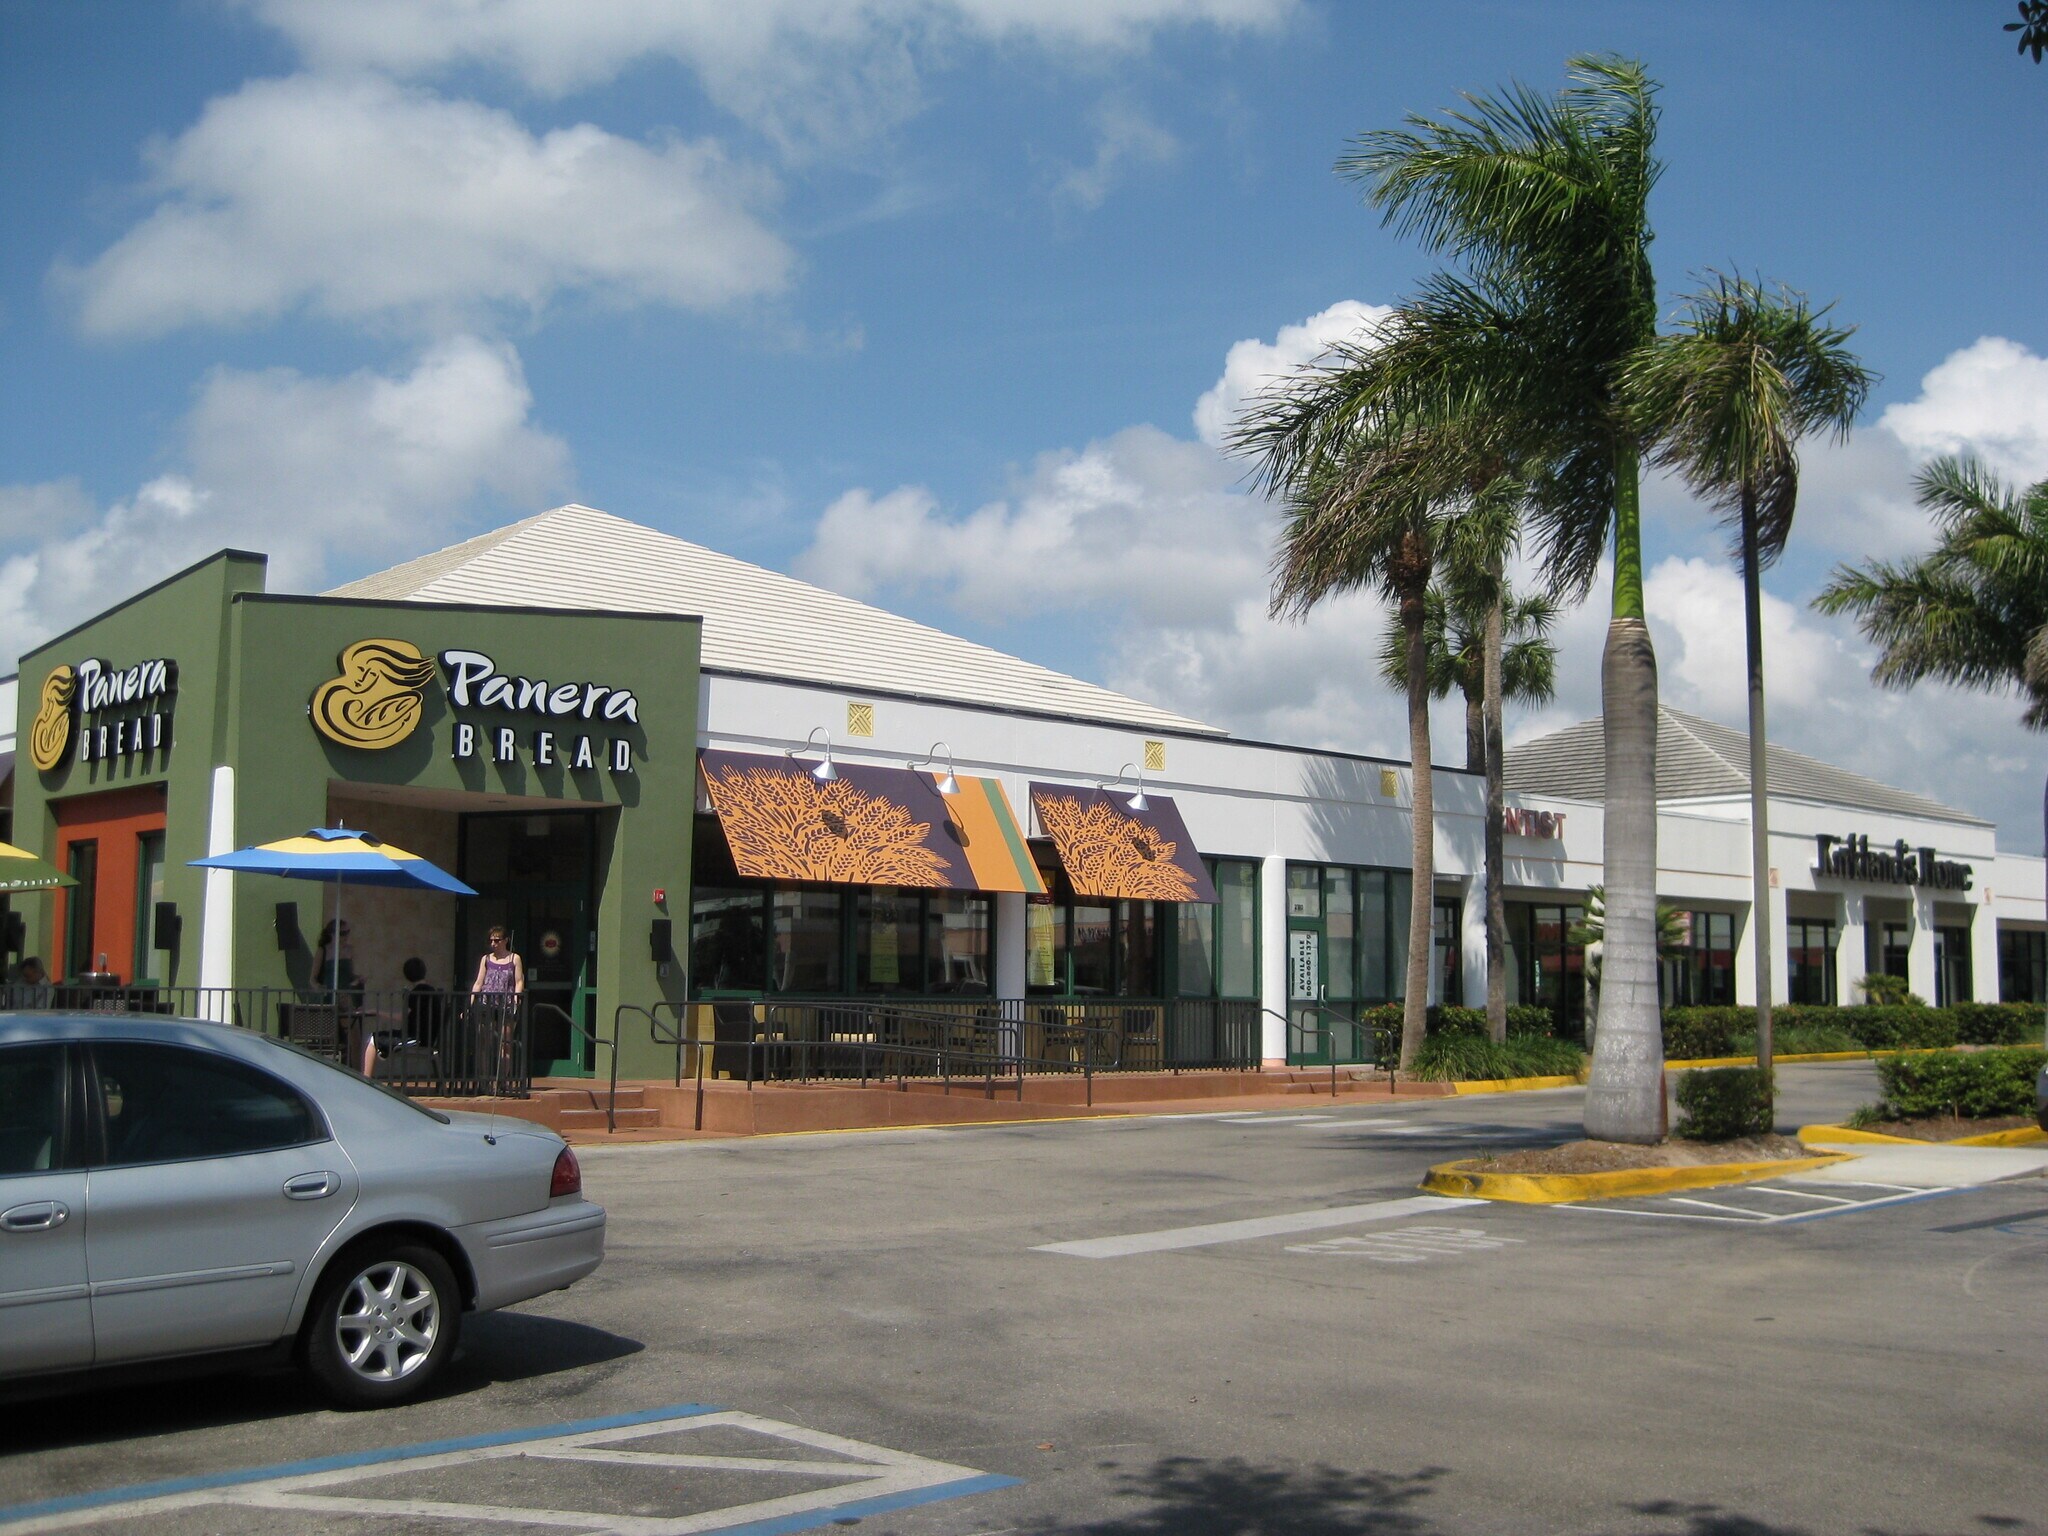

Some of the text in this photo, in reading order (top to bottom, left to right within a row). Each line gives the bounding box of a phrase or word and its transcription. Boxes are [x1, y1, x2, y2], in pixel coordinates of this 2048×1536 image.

[78, 657, 168, 713] Panera
[443, 650, 640, 724] Panera
[82, 713, 162, 762] BREAD
[457, 723, 631, 772] BREAD
[1504, 807, 1566, 839] NTIST
[1918, 847, 1974, 891] Home
[1284, 1226, 1527, 1262] STOP
